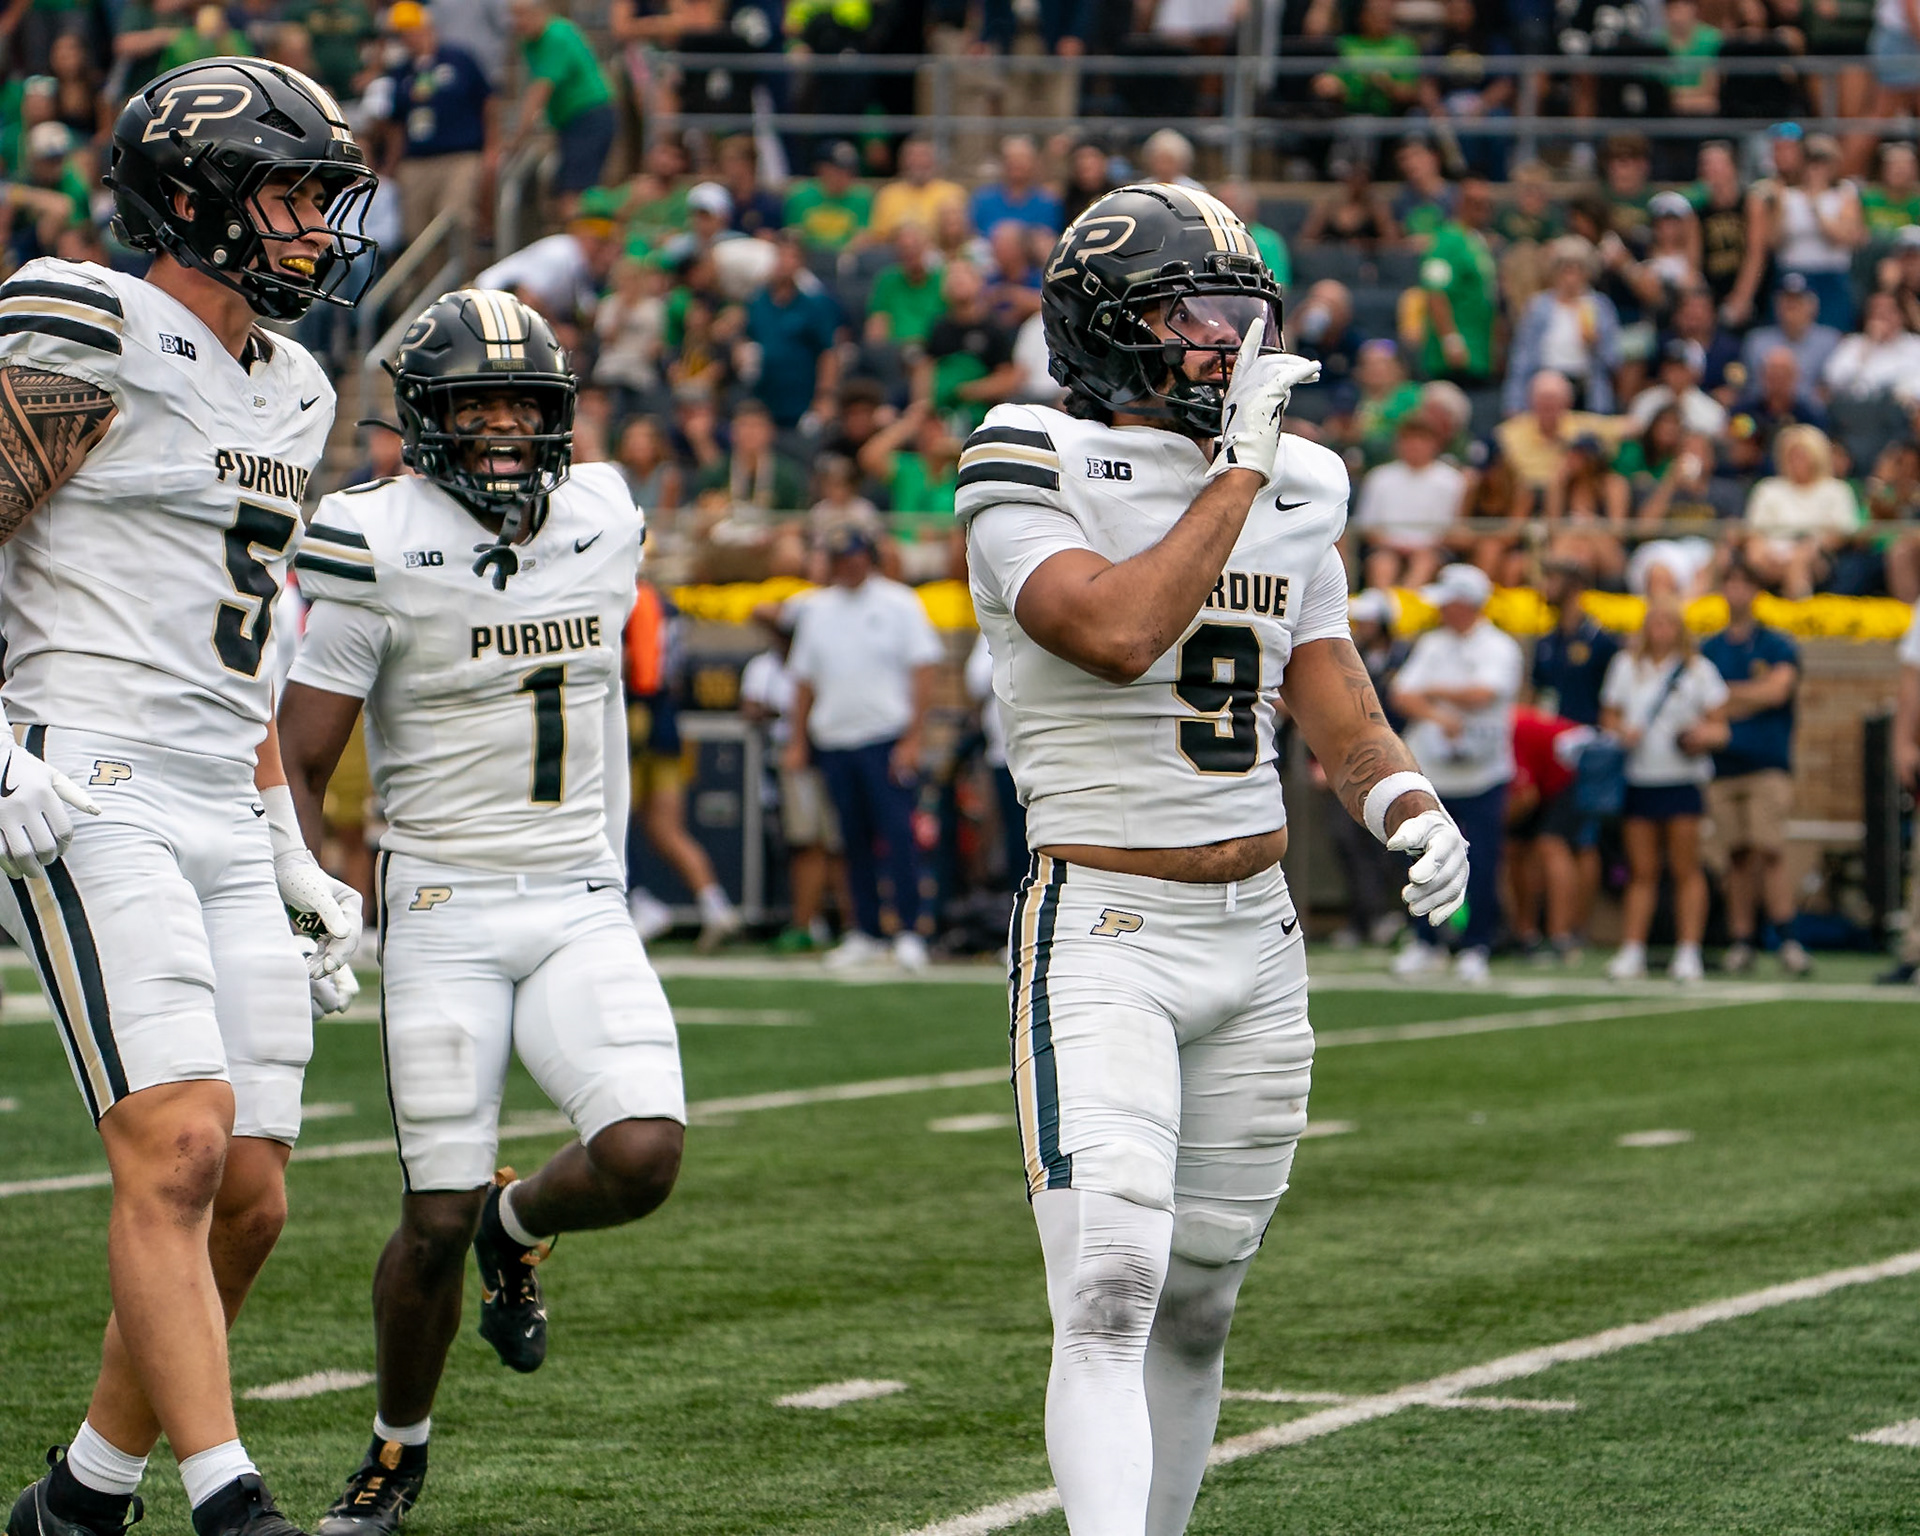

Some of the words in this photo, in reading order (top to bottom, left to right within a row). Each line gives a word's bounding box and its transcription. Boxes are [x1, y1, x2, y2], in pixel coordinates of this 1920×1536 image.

[142, 83, 252, 143] P
[1046, 215, 1137, 283] P
[253, 395, 266, 408] P
[211, 497, 298, 681] 5
[1203, 570, 1290, 619] RDUE
[470, 615, 601, 660] PURDUE
[1171, 619, 1263, 777] 9
[517, 662, 568, 807] 1
[88, 759, 133, 786] P
[408, 886, 453, 911] P
[1089, 907, 1144, 938] P
